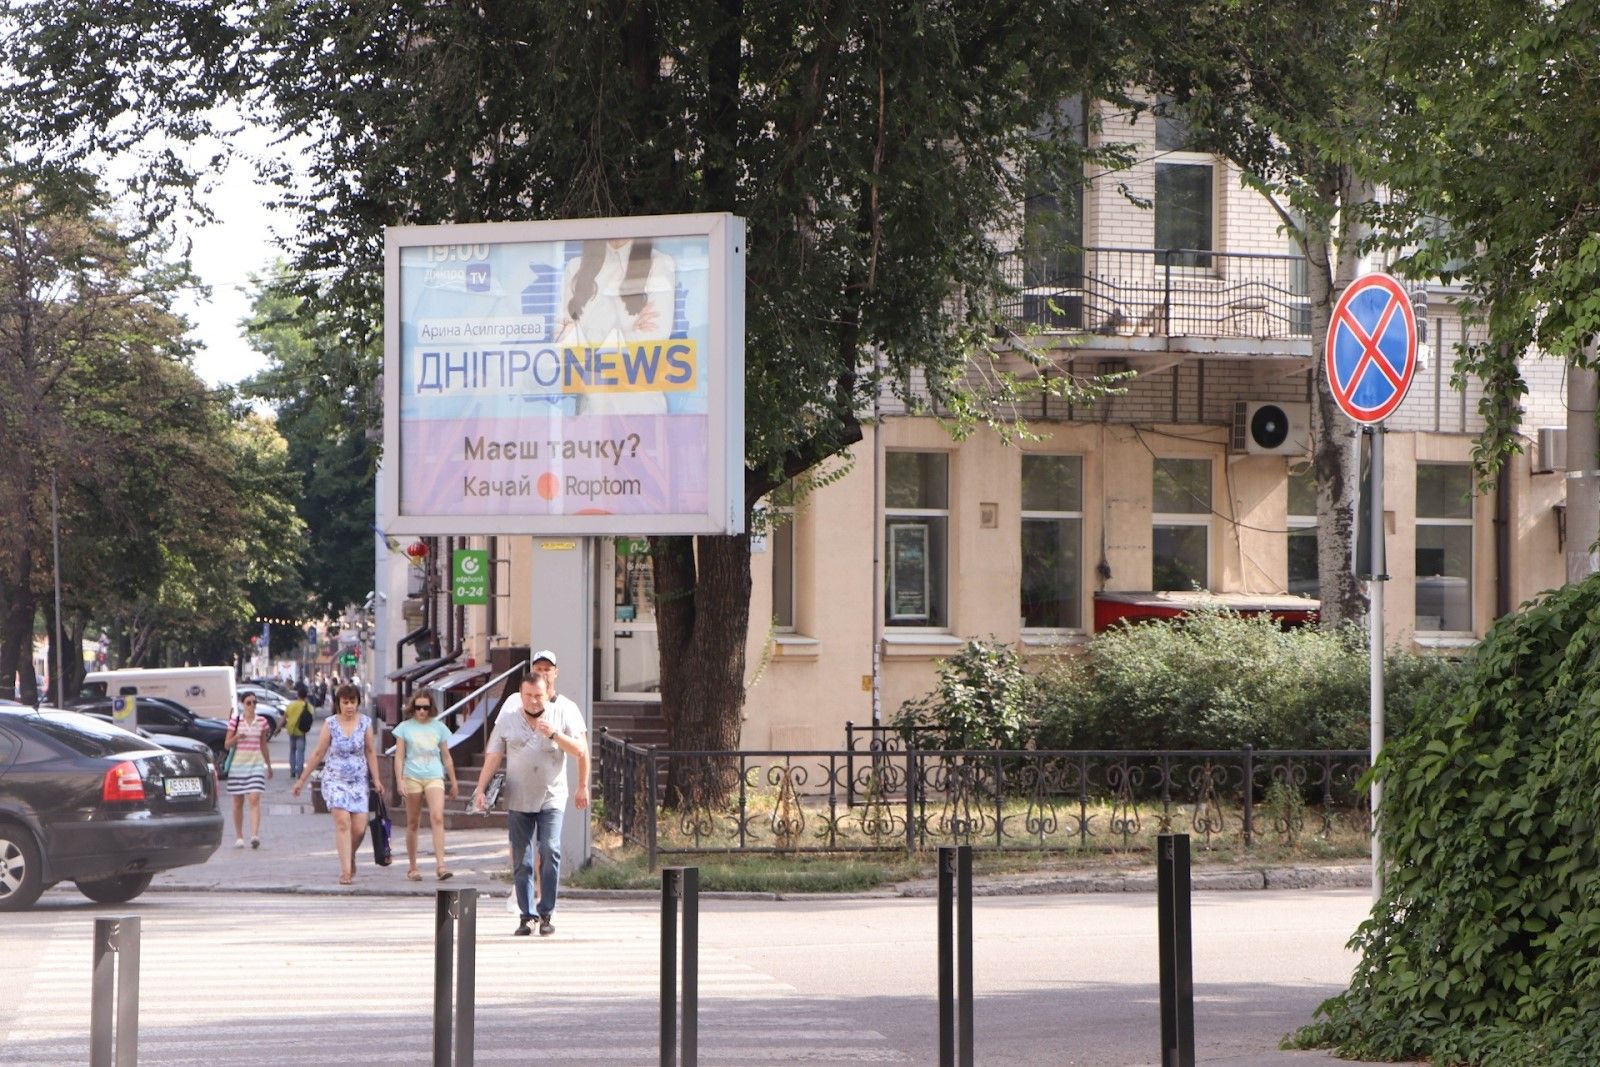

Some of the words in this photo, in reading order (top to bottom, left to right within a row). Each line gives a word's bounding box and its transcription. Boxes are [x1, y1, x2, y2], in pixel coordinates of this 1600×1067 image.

[427, 244, 490, 262] 19:00
[470, 272, 487, 284] TV
[421, 324, 460, 339] Арина
[463, 322, 541, 338] Асилгараєва
[464, 436, 538, 461] Маєш
[547, 433, 641, 466] тачку?
[464, 475, 531, 497] Качай
[565, 475, 641, 501] Raptom
[457, 586, 484, 597] 0-24
